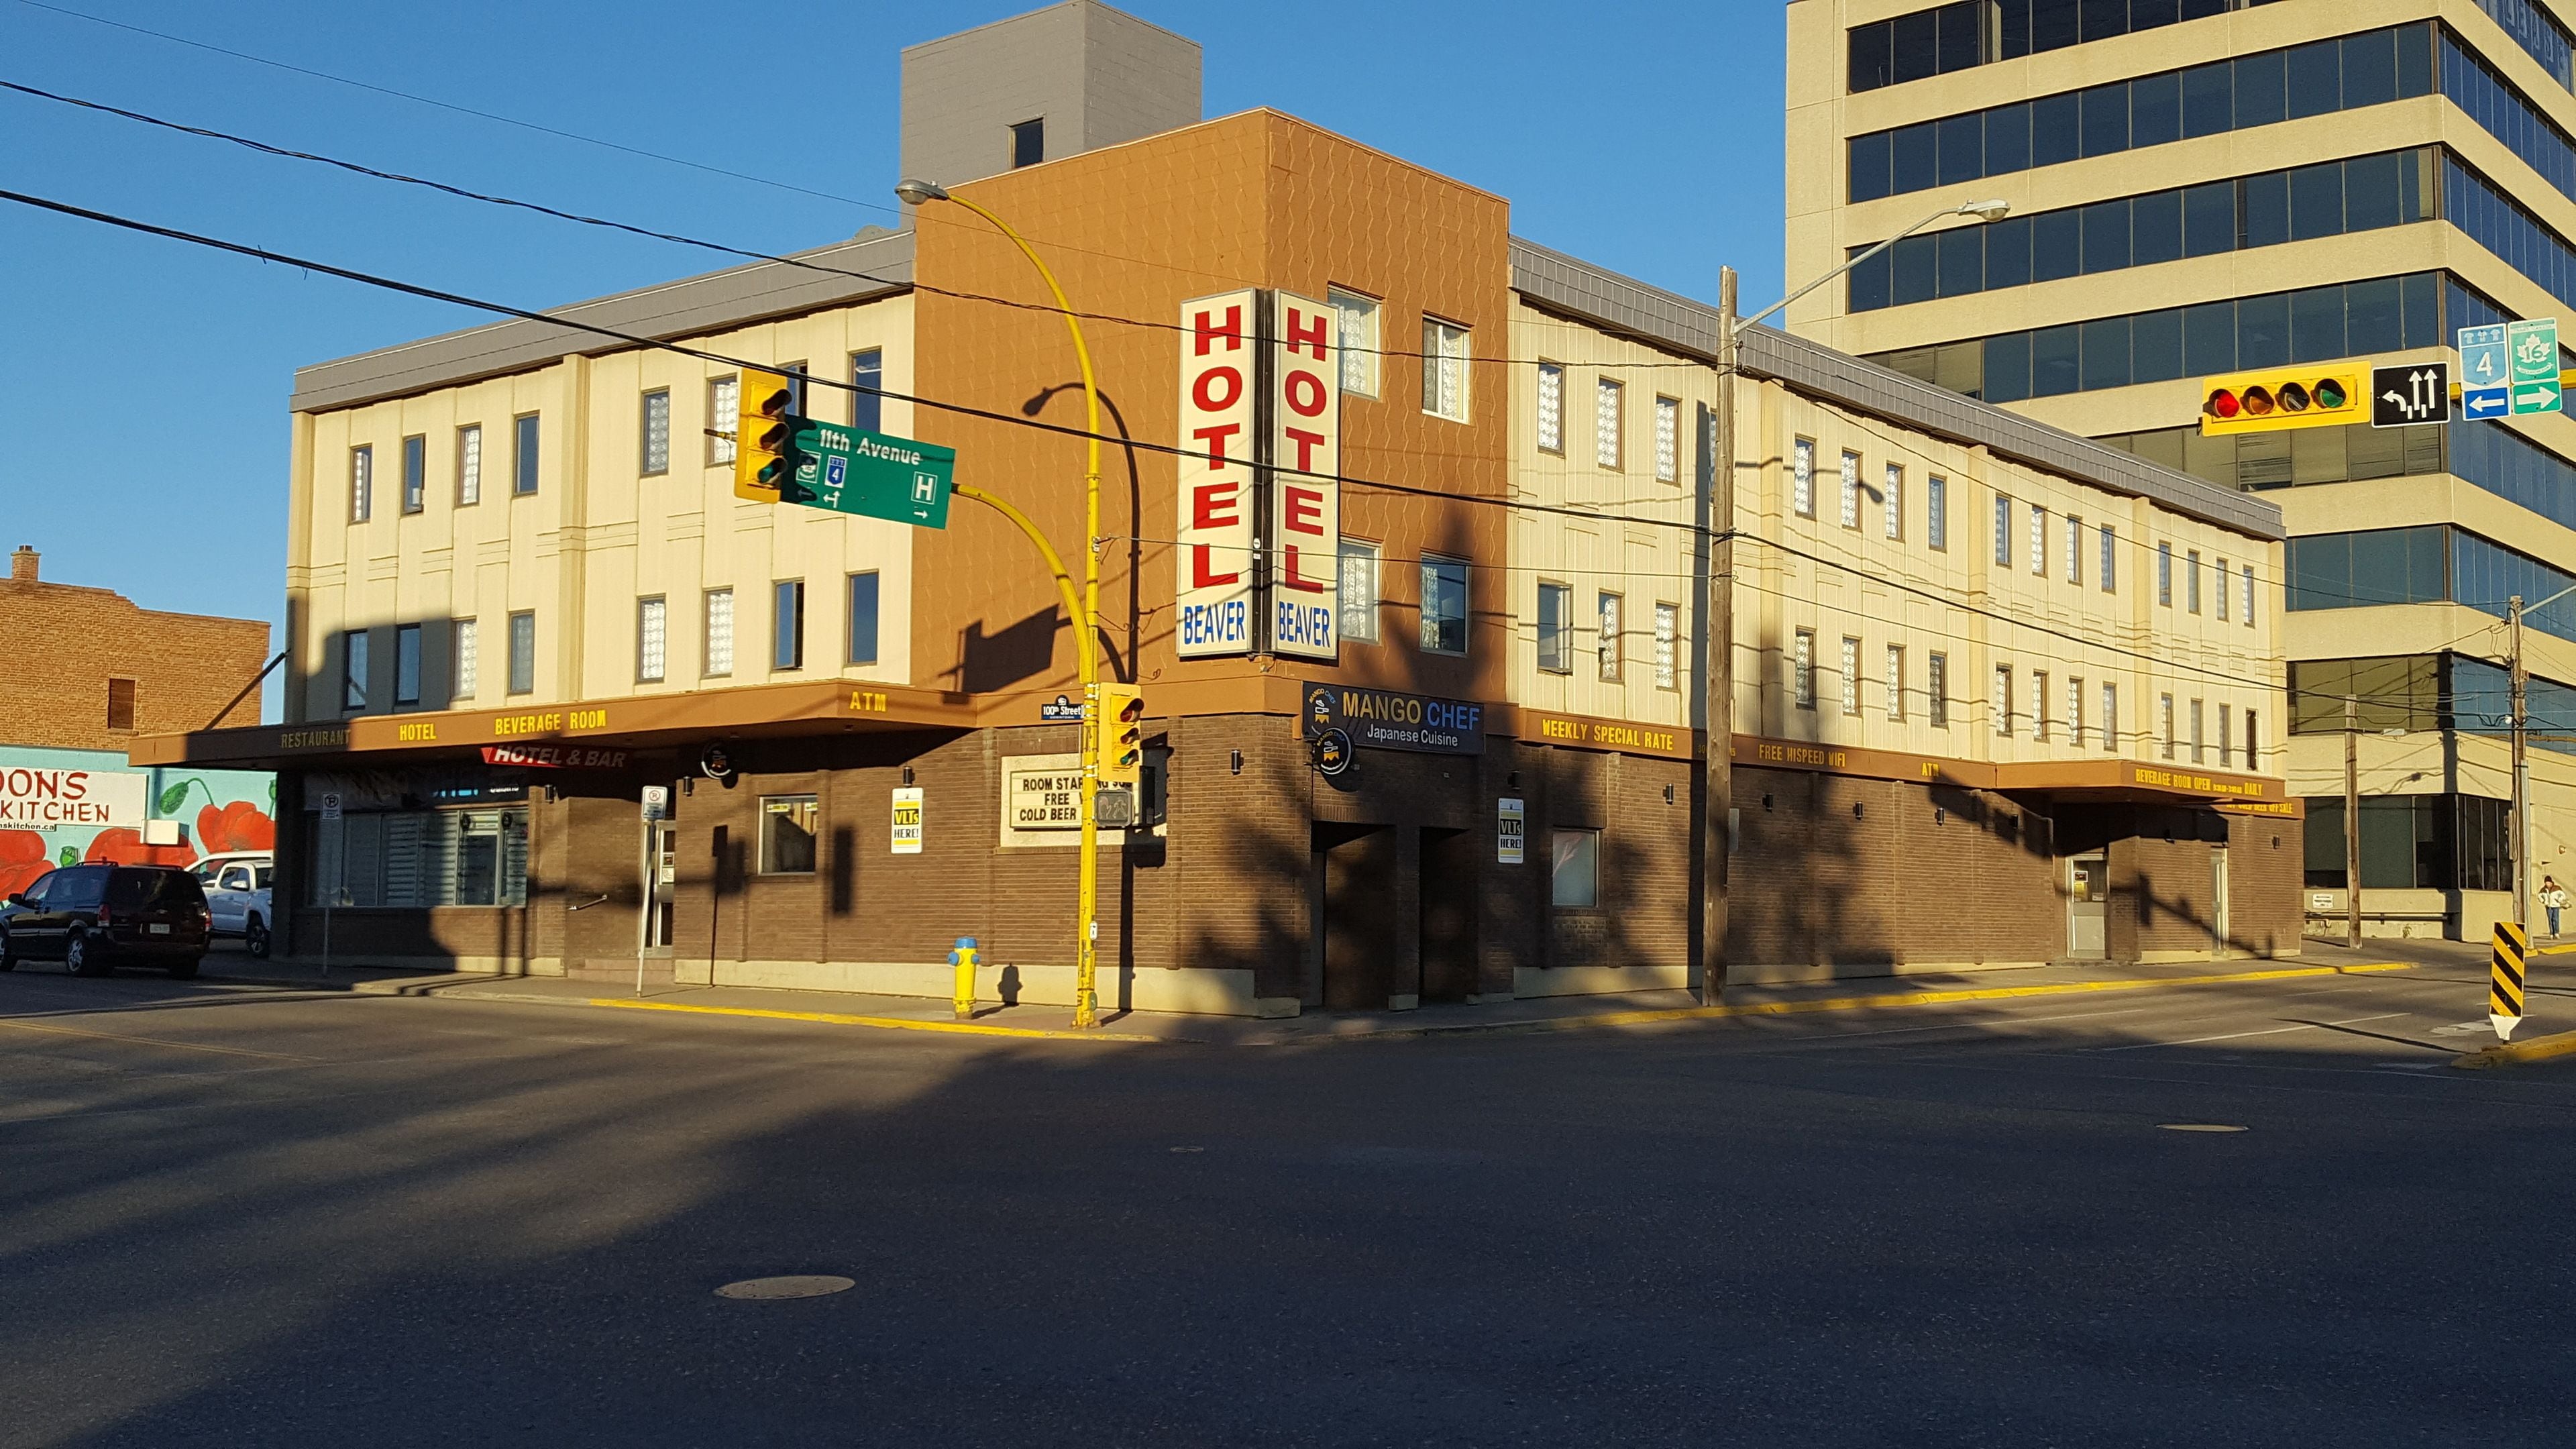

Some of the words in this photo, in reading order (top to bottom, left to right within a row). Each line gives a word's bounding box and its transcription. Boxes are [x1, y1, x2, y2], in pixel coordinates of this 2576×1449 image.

[2524, 344, 2544, 360] 16
[2476, 352, 2493, 376] 4
[820, 429, 851, 451] 11th
[856, 437, 922, 466] Avenue
[1192, 305, 1242, 589] HOTEL
[1284, 307, 1327, 594] HOTEL
[832, 468, 841, 481] 4
[915, 475, 934, 501] H
[1183, 600, 1246, 645] BEAVER
[1278, 600, 1331, 649] BEAVER
[849, 691, 886, 712] ATM
[1060, 706, 1081, 716] Street
[1342, 691, 1421, 724] MANGO
[1427, 702, 1479, 731] CHEF
[399, 724, 436, 741] HOTEL
[494, 714, 561, 736] BEVERAGE
[570, 709, 606, 730] ROOM
[281, 729, 352, 749] RESTAURANT
[1367, 723, 1419, 743] Japanese
[1420, 729, 1458, 747] Cuisine
[1542, 719, 1589, 740] WEEKLY
[1593, 724, 1640, 747] SPECIAL
[1644, 731, 1674, 751] RATE
[493, 745, 564, 765] HOTEL
[566, 749, 581, 765] &
[584, 751, 627, 767] BAR
[1758, 744, 1782, 761] FREE
[1786, 746, 1825, 765] HISPEED
[1828, 752, 1845, 767] WIFI
[0, 769, 89, 800] ON'S
[1023, 777, 1053, 792] ROOM
[2136, 769, 2171, 786] BEVERAGE
[2174, 774, 2192, 789] ROOM
[2194, 777, 2212, 791] OPEN
[2245, 782, 2263, 796] DAILY
[1044, 793, 1070, 805] FREE
[0, 800, 109, 822] KITCHEN
[894, 810, 919, 825] VLTs
[1020, 808, 1046, 821] COLD
[1051, 808, 1077, 820] BEER
[894, 828, 919, 839] HERE!
[1501, 820, 1521, 835] VLTs
[1500, 838, 1521, 849] HERE!
